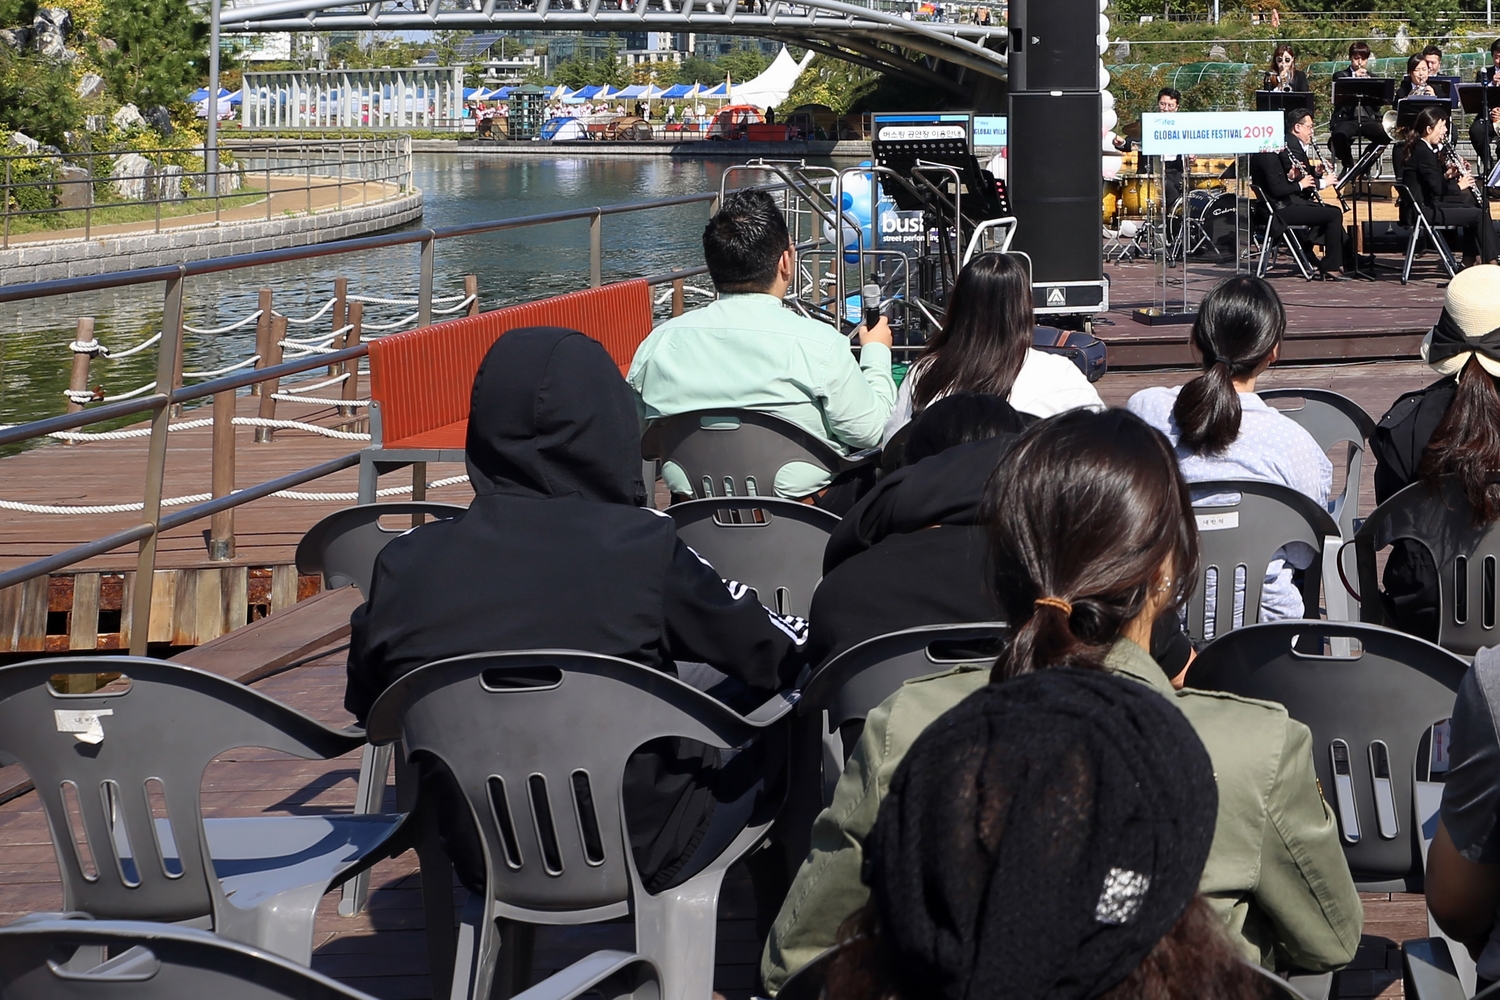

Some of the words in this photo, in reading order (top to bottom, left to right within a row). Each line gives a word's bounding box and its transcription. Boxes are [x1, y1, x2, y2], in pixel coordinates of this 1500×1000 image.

[1154, 130, 1180, 140] GLOBAL
[1182, 129, 1210, 139] VILLAGE
[1211, 129, 1242, 139] FESTIVAL
[1243, 126, 1274, 138] 2019
